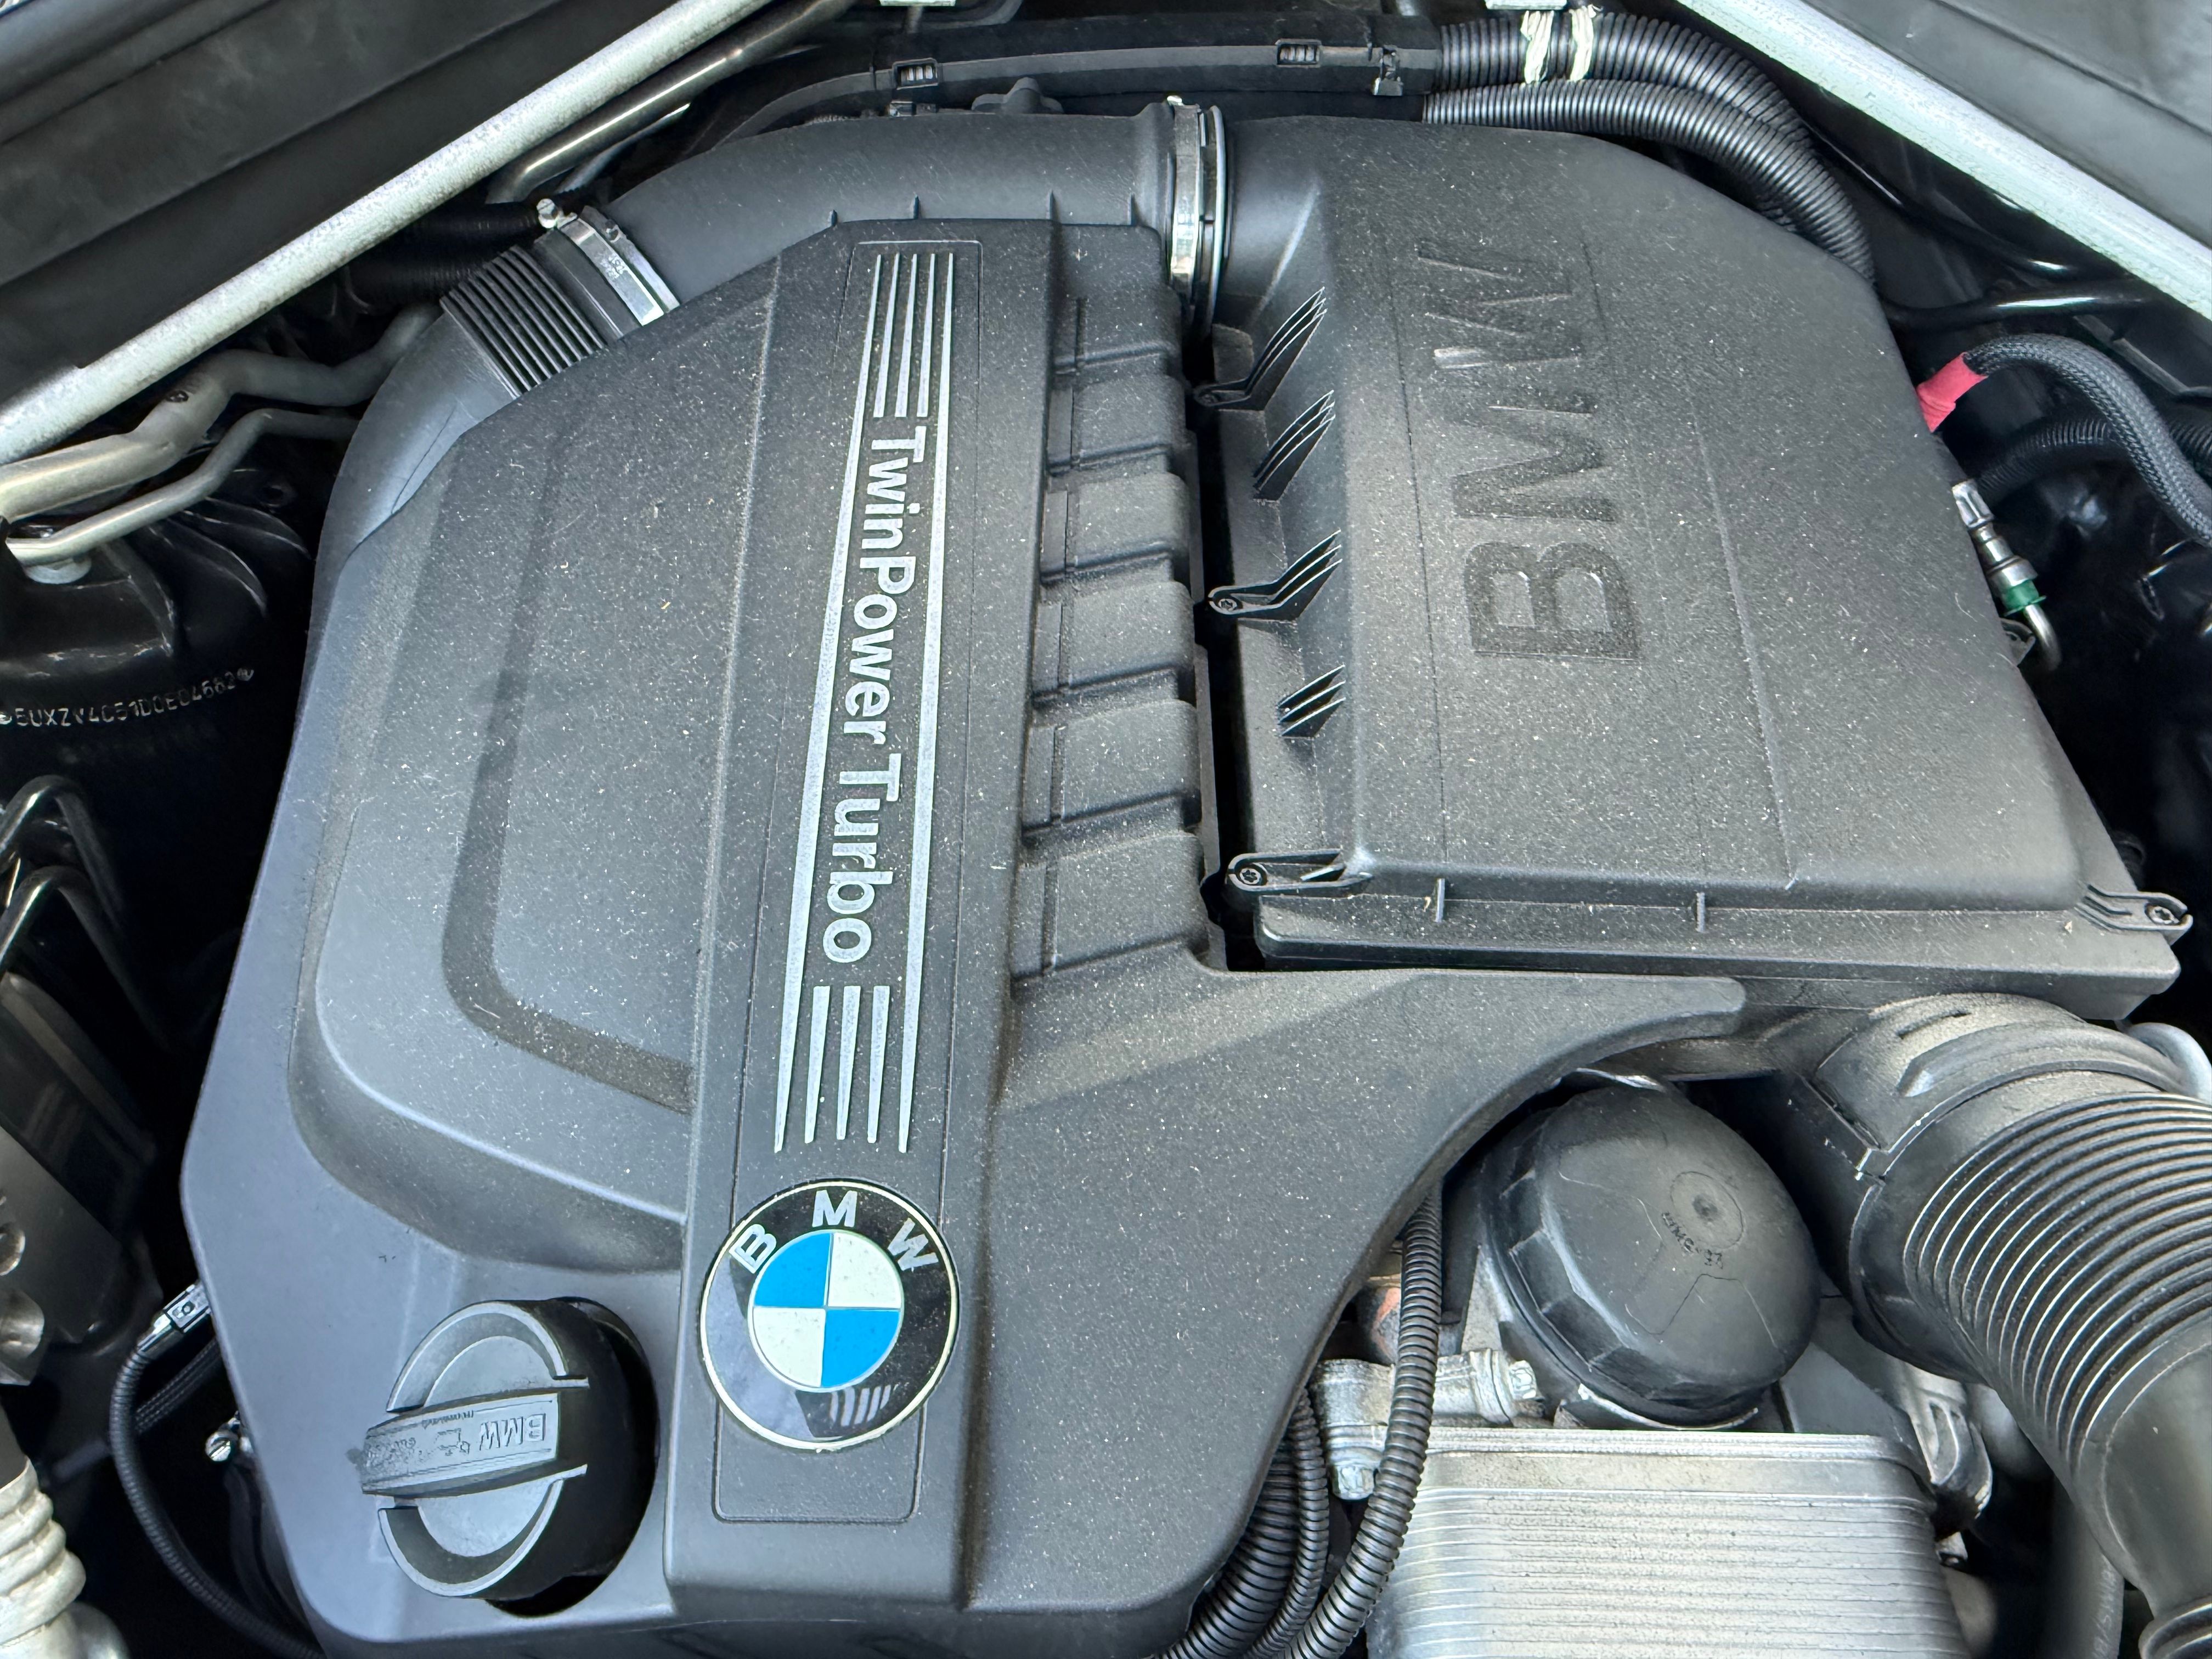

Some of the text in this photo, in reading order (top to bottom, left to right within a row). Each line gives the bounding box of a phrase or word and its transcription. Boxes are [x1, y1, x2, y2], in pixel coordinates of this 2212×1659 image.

[1416, 239, 1641, 661] BMW
[823, 426, 927, 963] TwinPower Turbo
[729, 1189, 939, 1274] BMW
[478, 1413, 546, 1451] BMW
